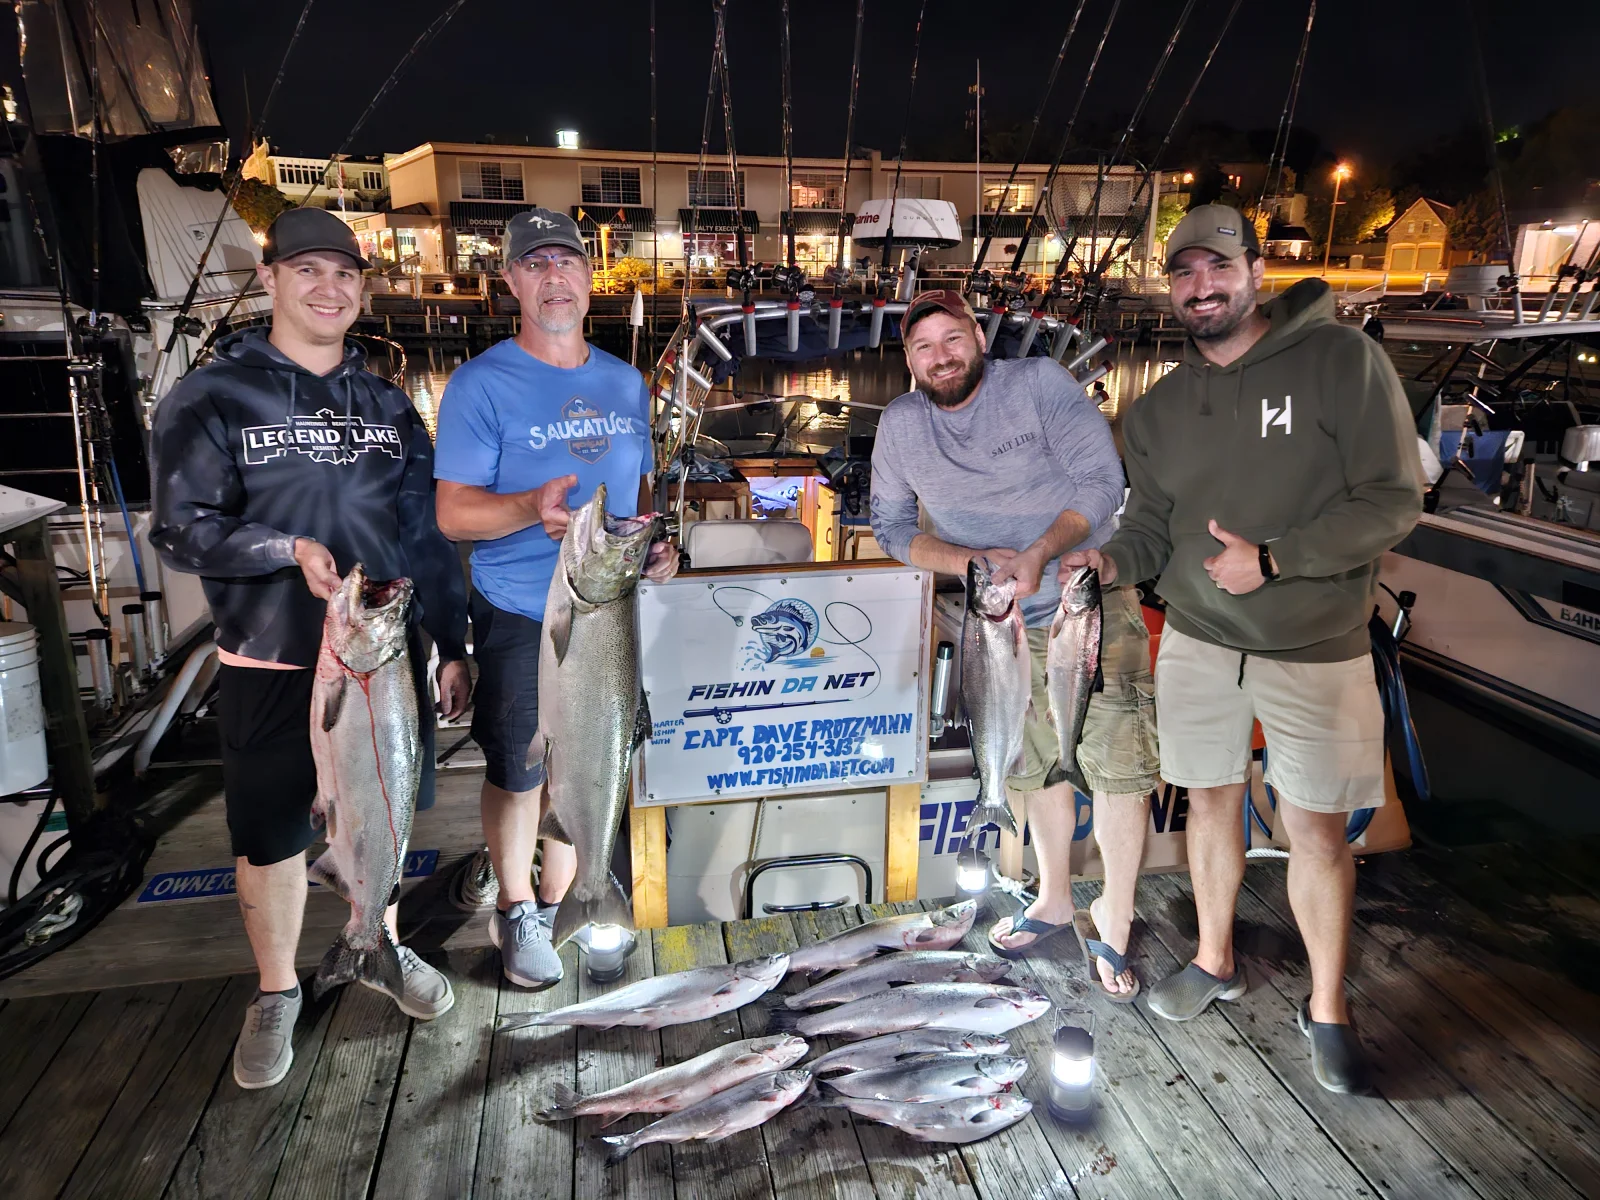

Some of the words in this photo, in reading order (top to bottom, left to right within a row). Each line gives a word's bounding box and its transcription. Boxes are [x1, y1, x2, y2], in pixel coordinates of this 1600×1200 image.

[469, 218, 504, 227] DOCKSIDE
[715, 225, 752, 233] EXECUTES
[855, 212, 880, 225] arine
[249, 428, 341, 449] LEGEND
[351, 428, 399, 444] LAKE
[528, 411, 636, 449] SAUGATUCK
[991, 440, 1013, 457] SALT
[1014, 431, 1038, 447] LIFE
[687, 679, 776, 701] FISHIN
[780, 675, 819, 694] DA
[823, 671, 876, 690] NET
[652, 718, 685, 729] HARTER
[652, 728, 676, 737] ISHIN
[683, 726, 744, 750] CAPT.
[752, 721, 808, 745] DAVE
[810, 713, 913, 741] PROTZMANN
[153, 872, 236, 897] OWNER
